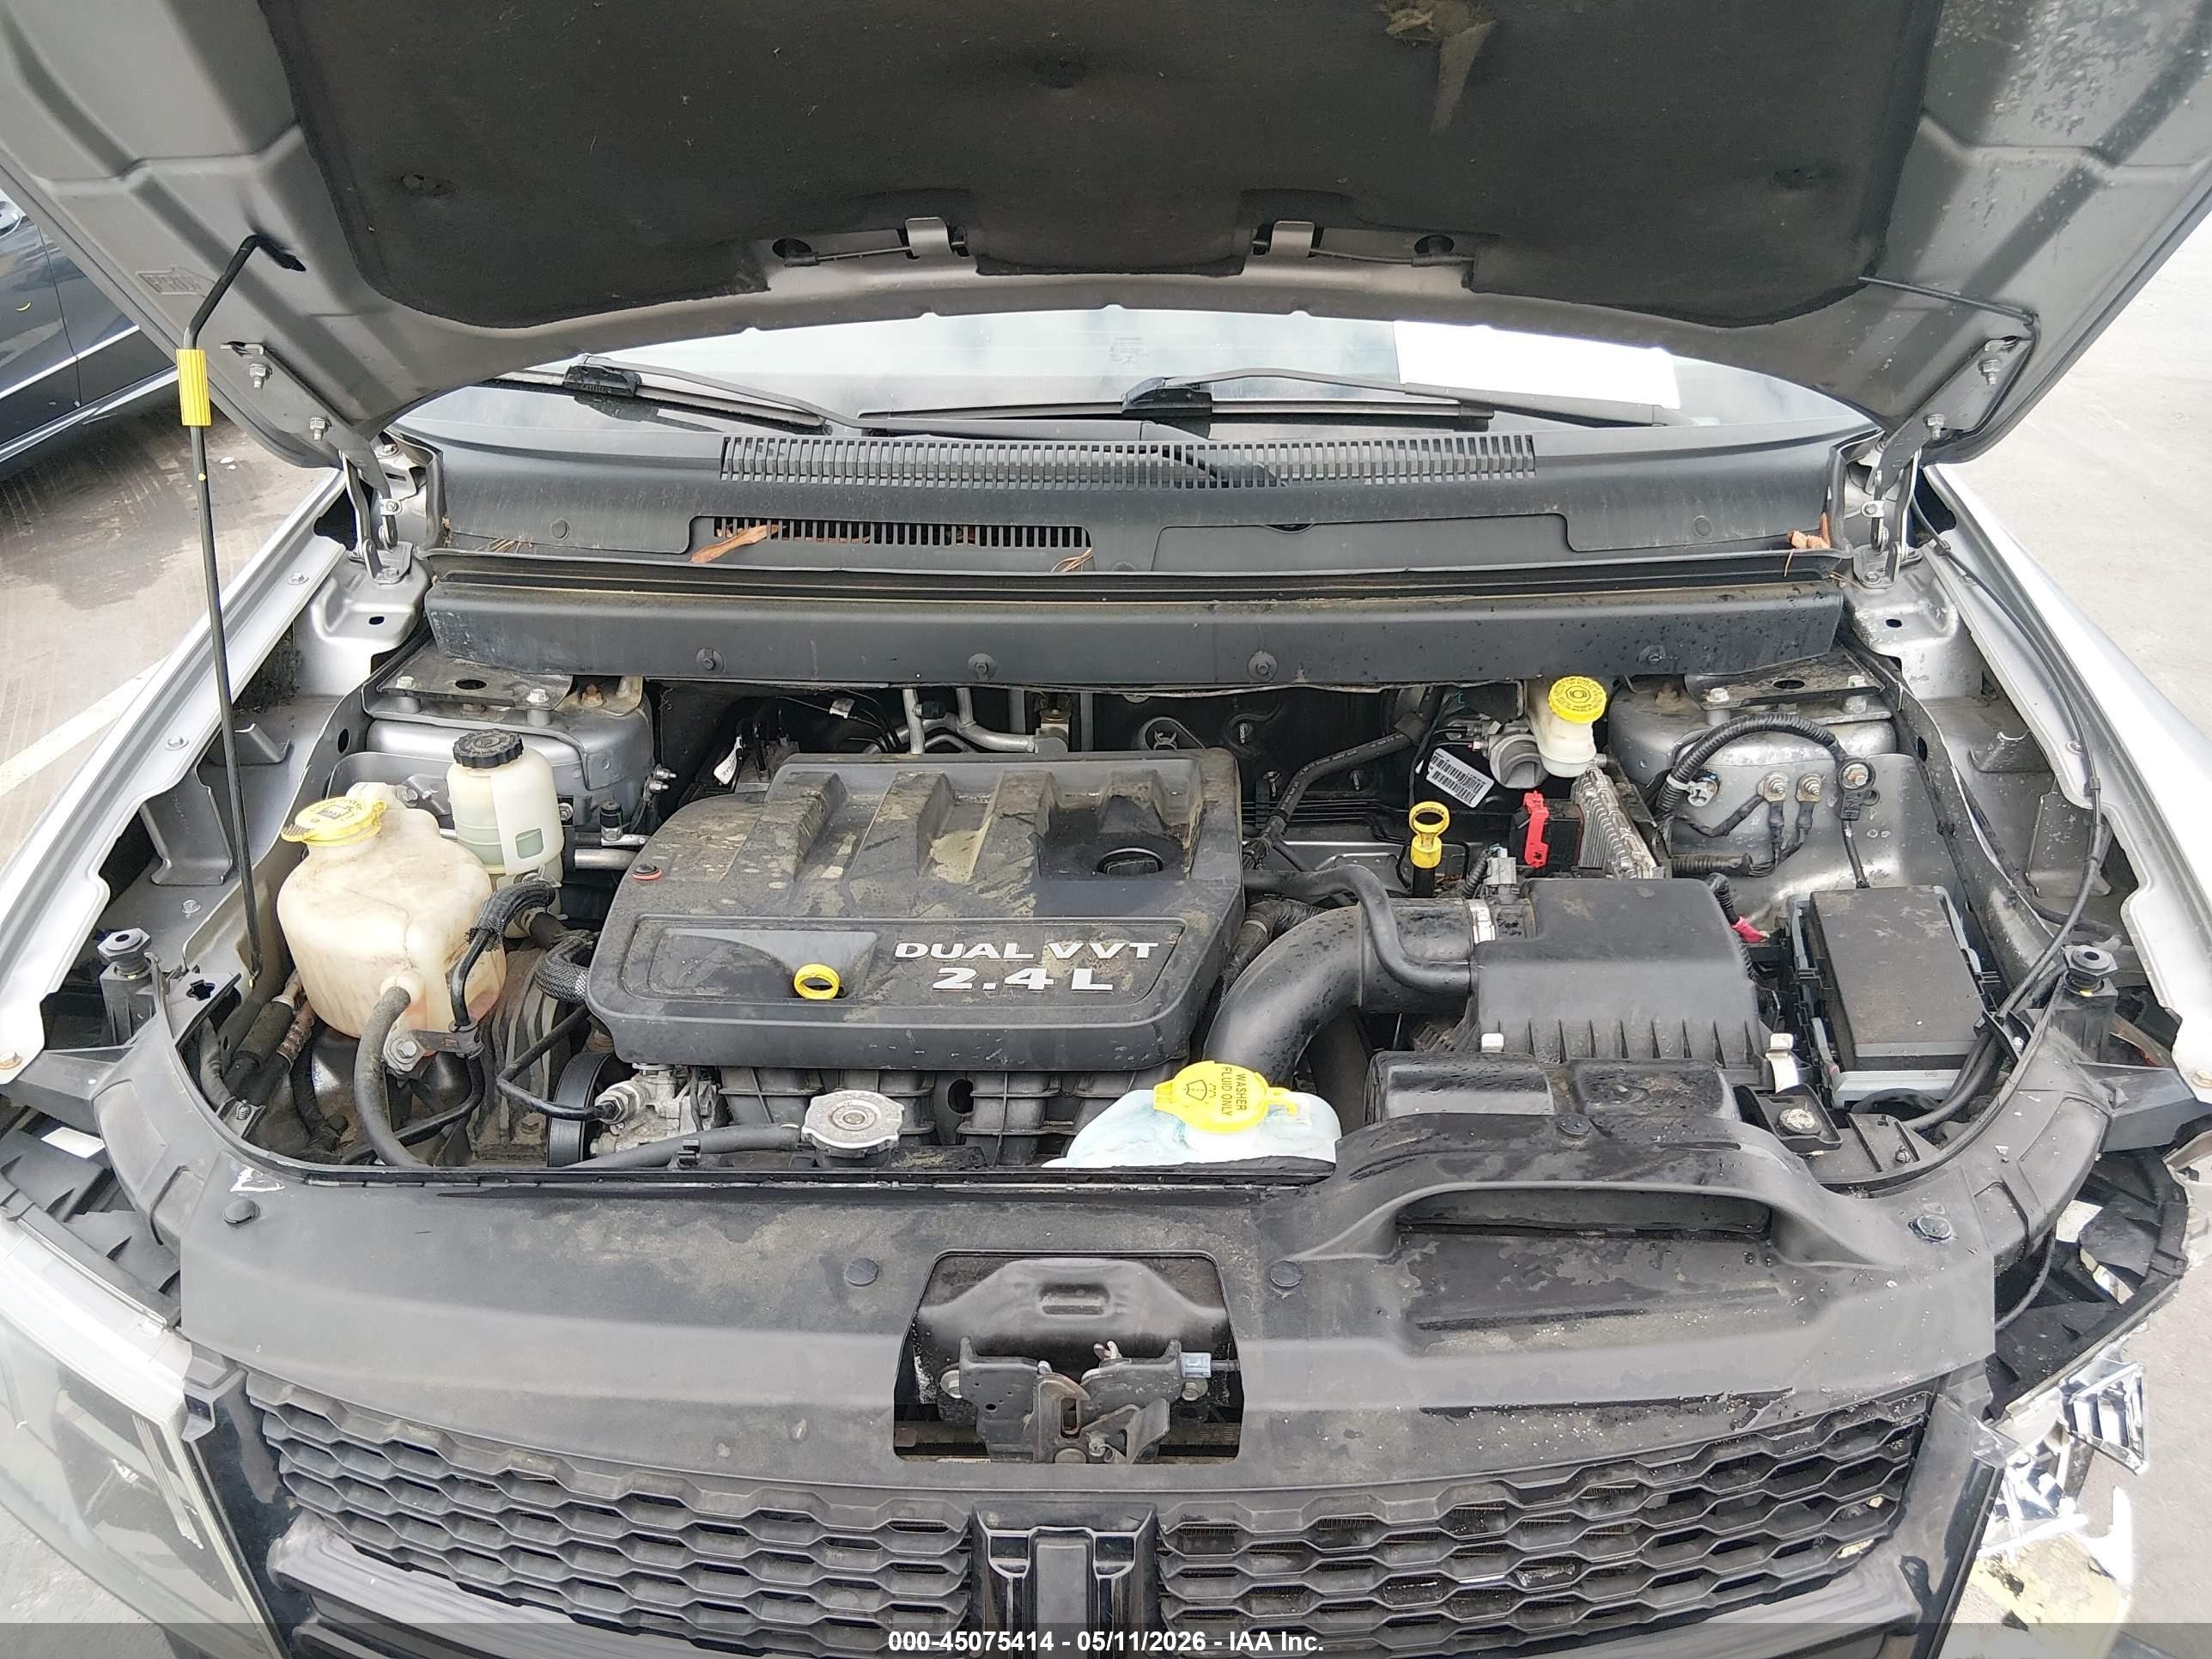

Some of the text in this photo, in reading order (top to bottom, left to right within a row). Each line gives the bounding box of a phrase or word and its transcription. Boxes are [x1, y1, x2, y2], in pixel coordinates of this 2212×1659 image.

[894, 942, 1159, 960] DUAL VVT
[1221, 1066, 1233, 1116] FLUID ONLY
[1236, 1073, 1247, 1110] WASHER
